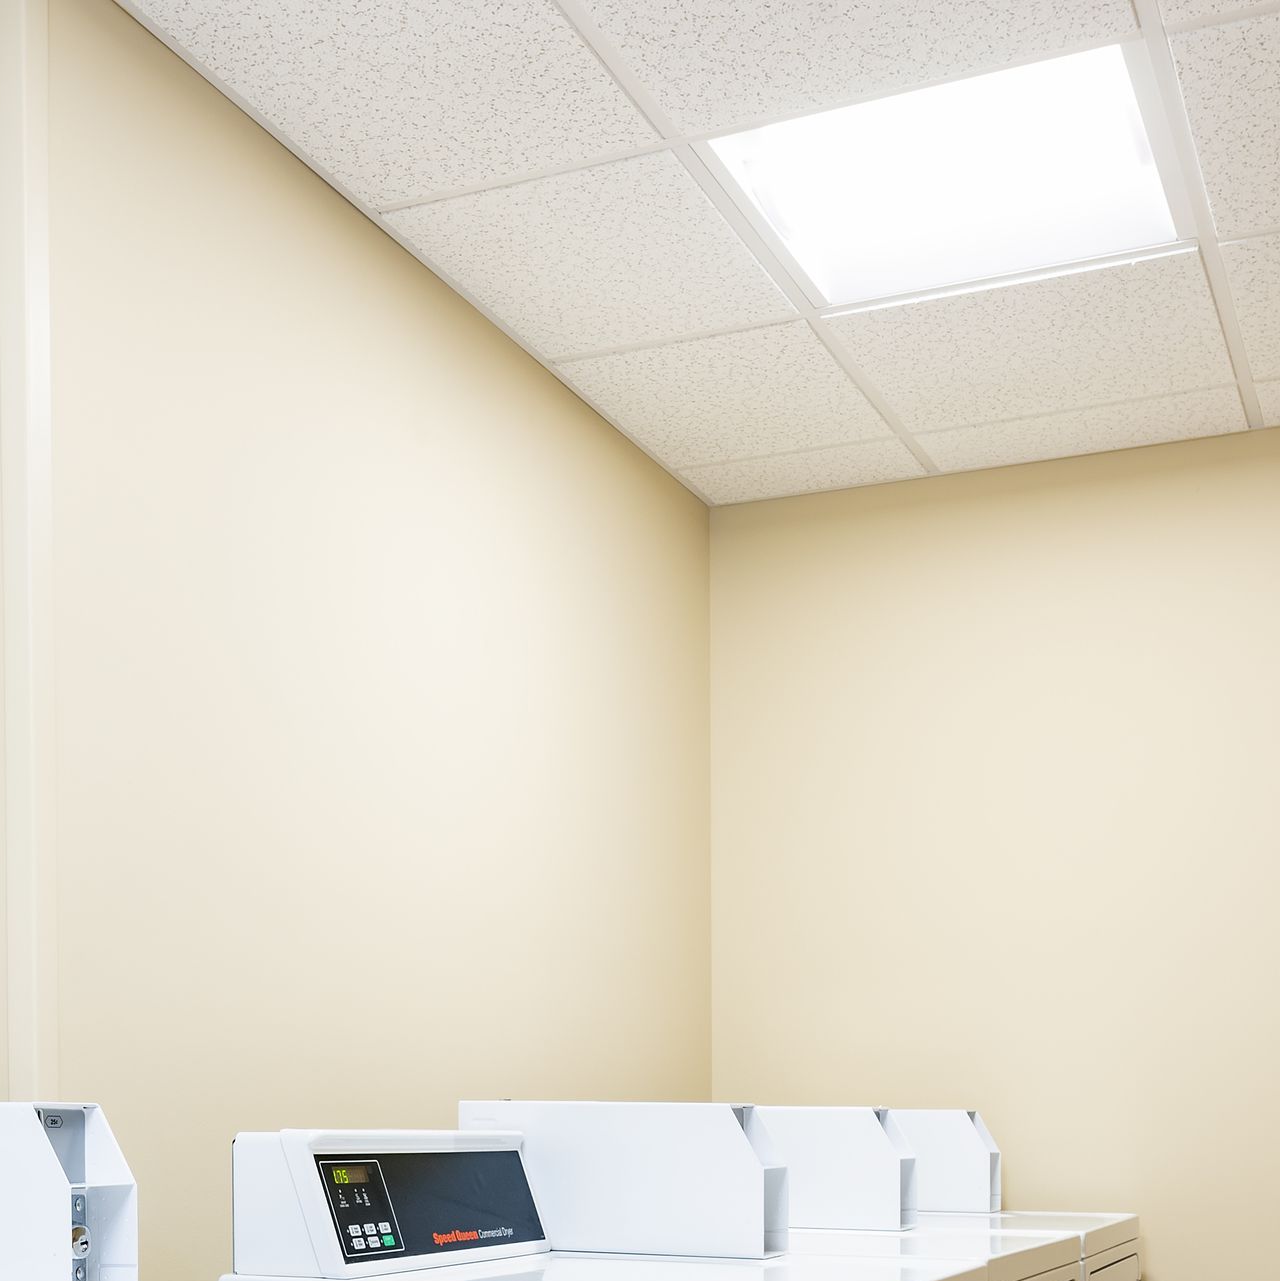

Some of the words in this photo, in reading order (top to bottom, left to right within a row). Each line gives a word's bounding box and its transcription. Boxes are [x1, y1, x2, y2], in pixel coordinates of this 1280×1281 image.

[432, 1230, 457, 1246] Speed
[456, 1229, 479, 1241] Queen
[478, 1227, 502, 1239] Commercial
